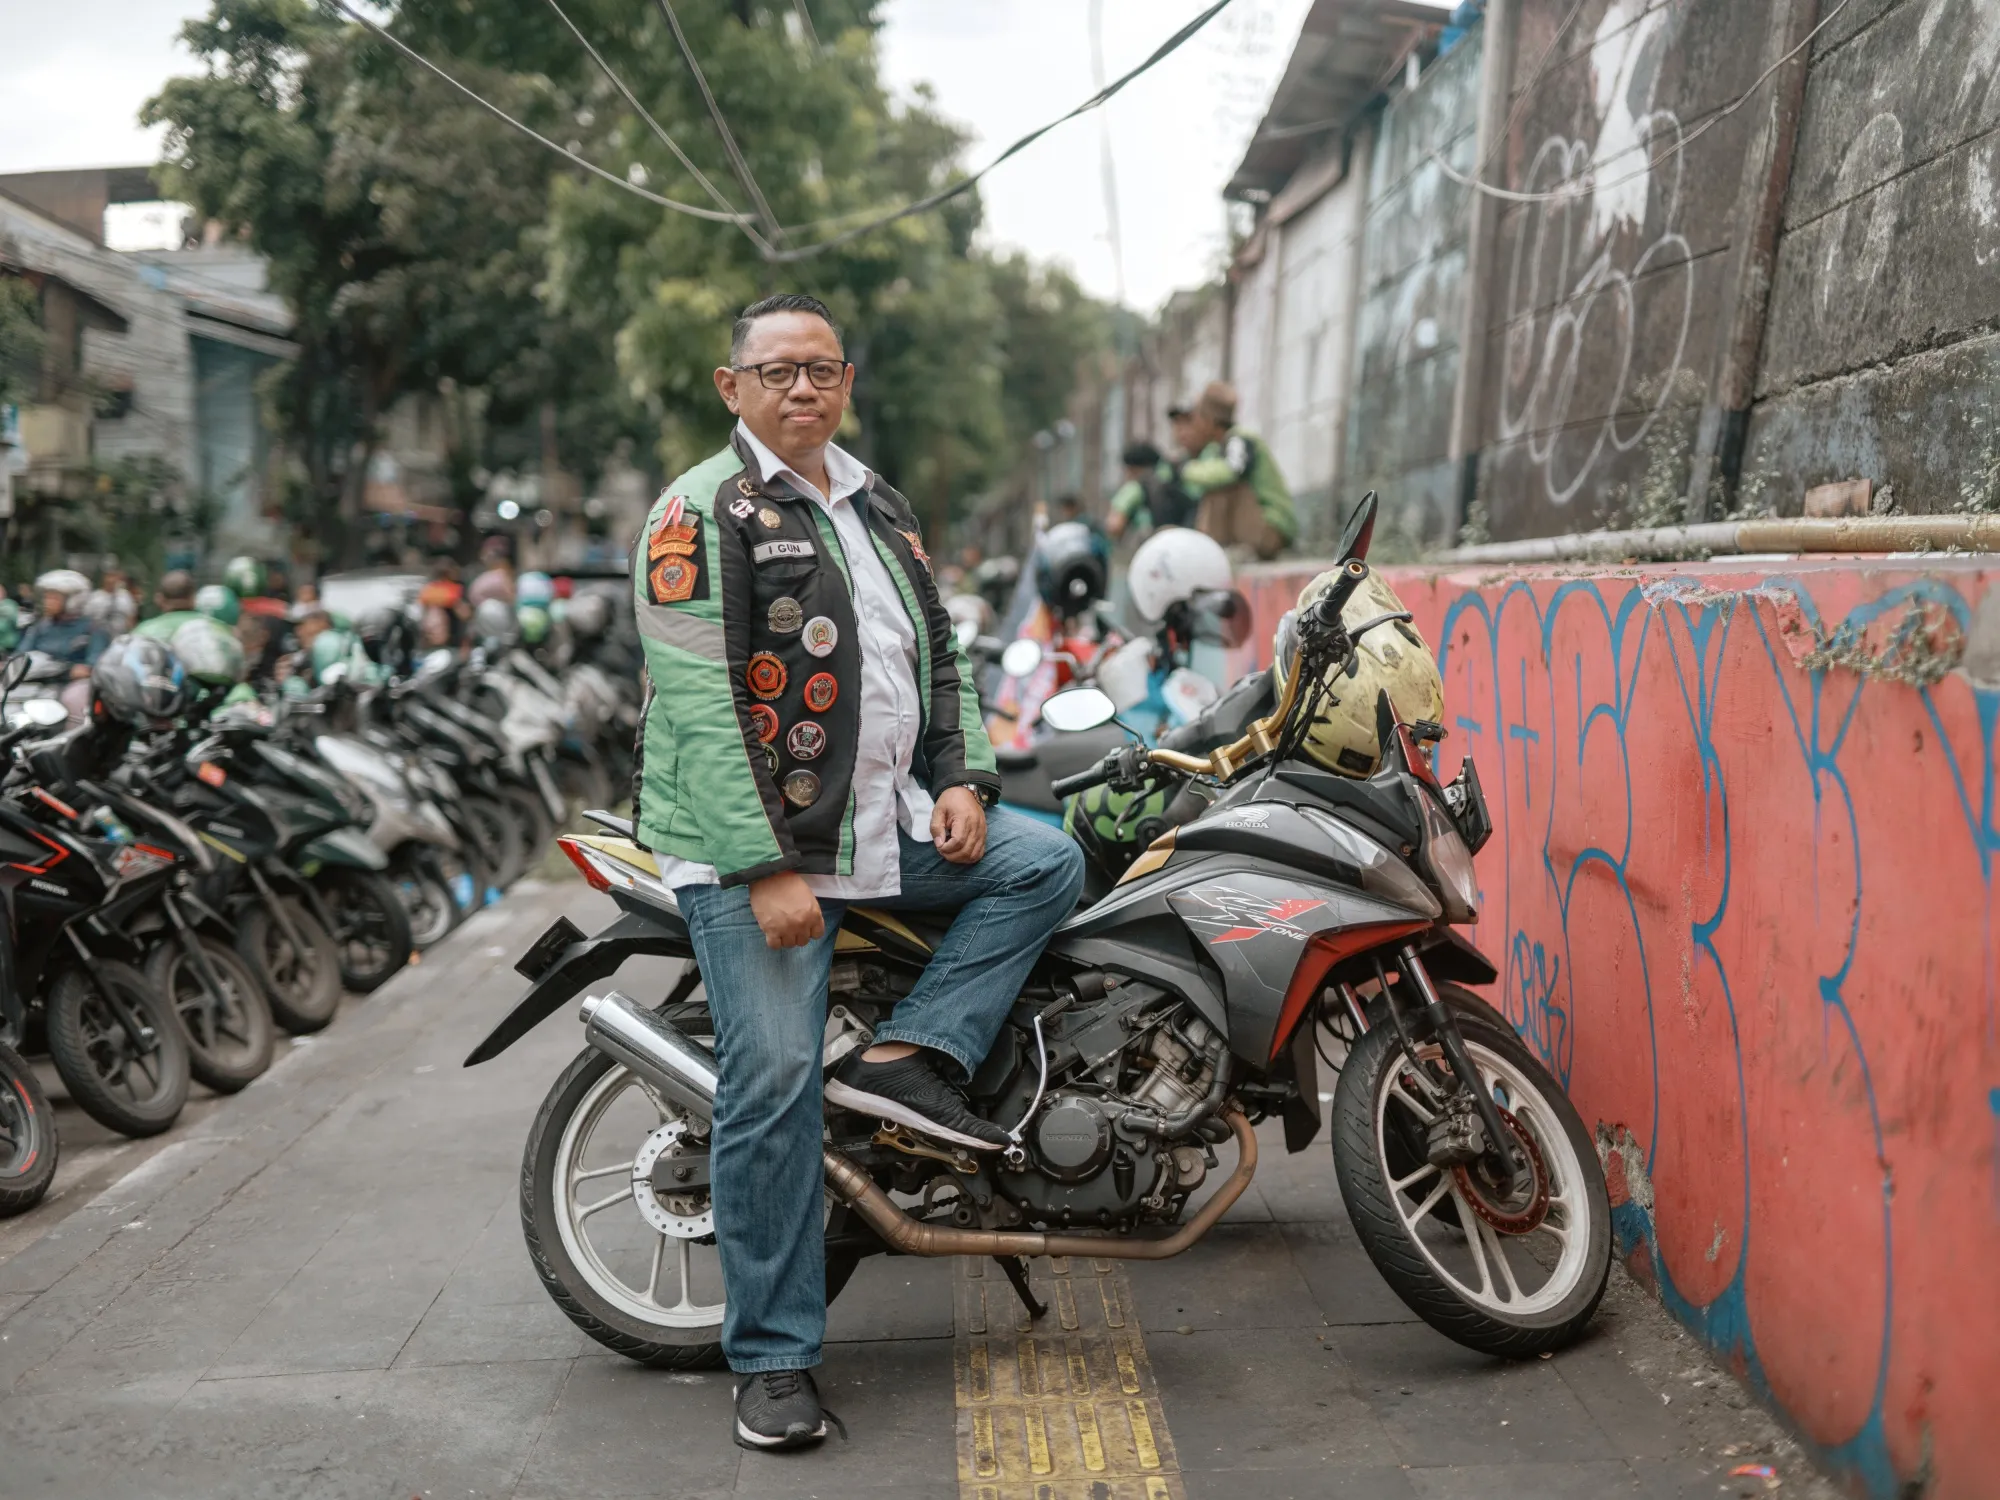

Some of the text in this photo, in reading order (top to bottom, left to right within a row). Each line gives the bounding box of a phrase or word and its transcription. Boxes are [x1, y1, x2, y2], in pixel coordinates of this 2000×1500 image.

[777, 543, 801, 554] GUN
[1225, 821, 1270, 829] HONDA
[1270, 926, 1309, 941] ONE
[1045, 1133, 1092, 1141] HONDA
